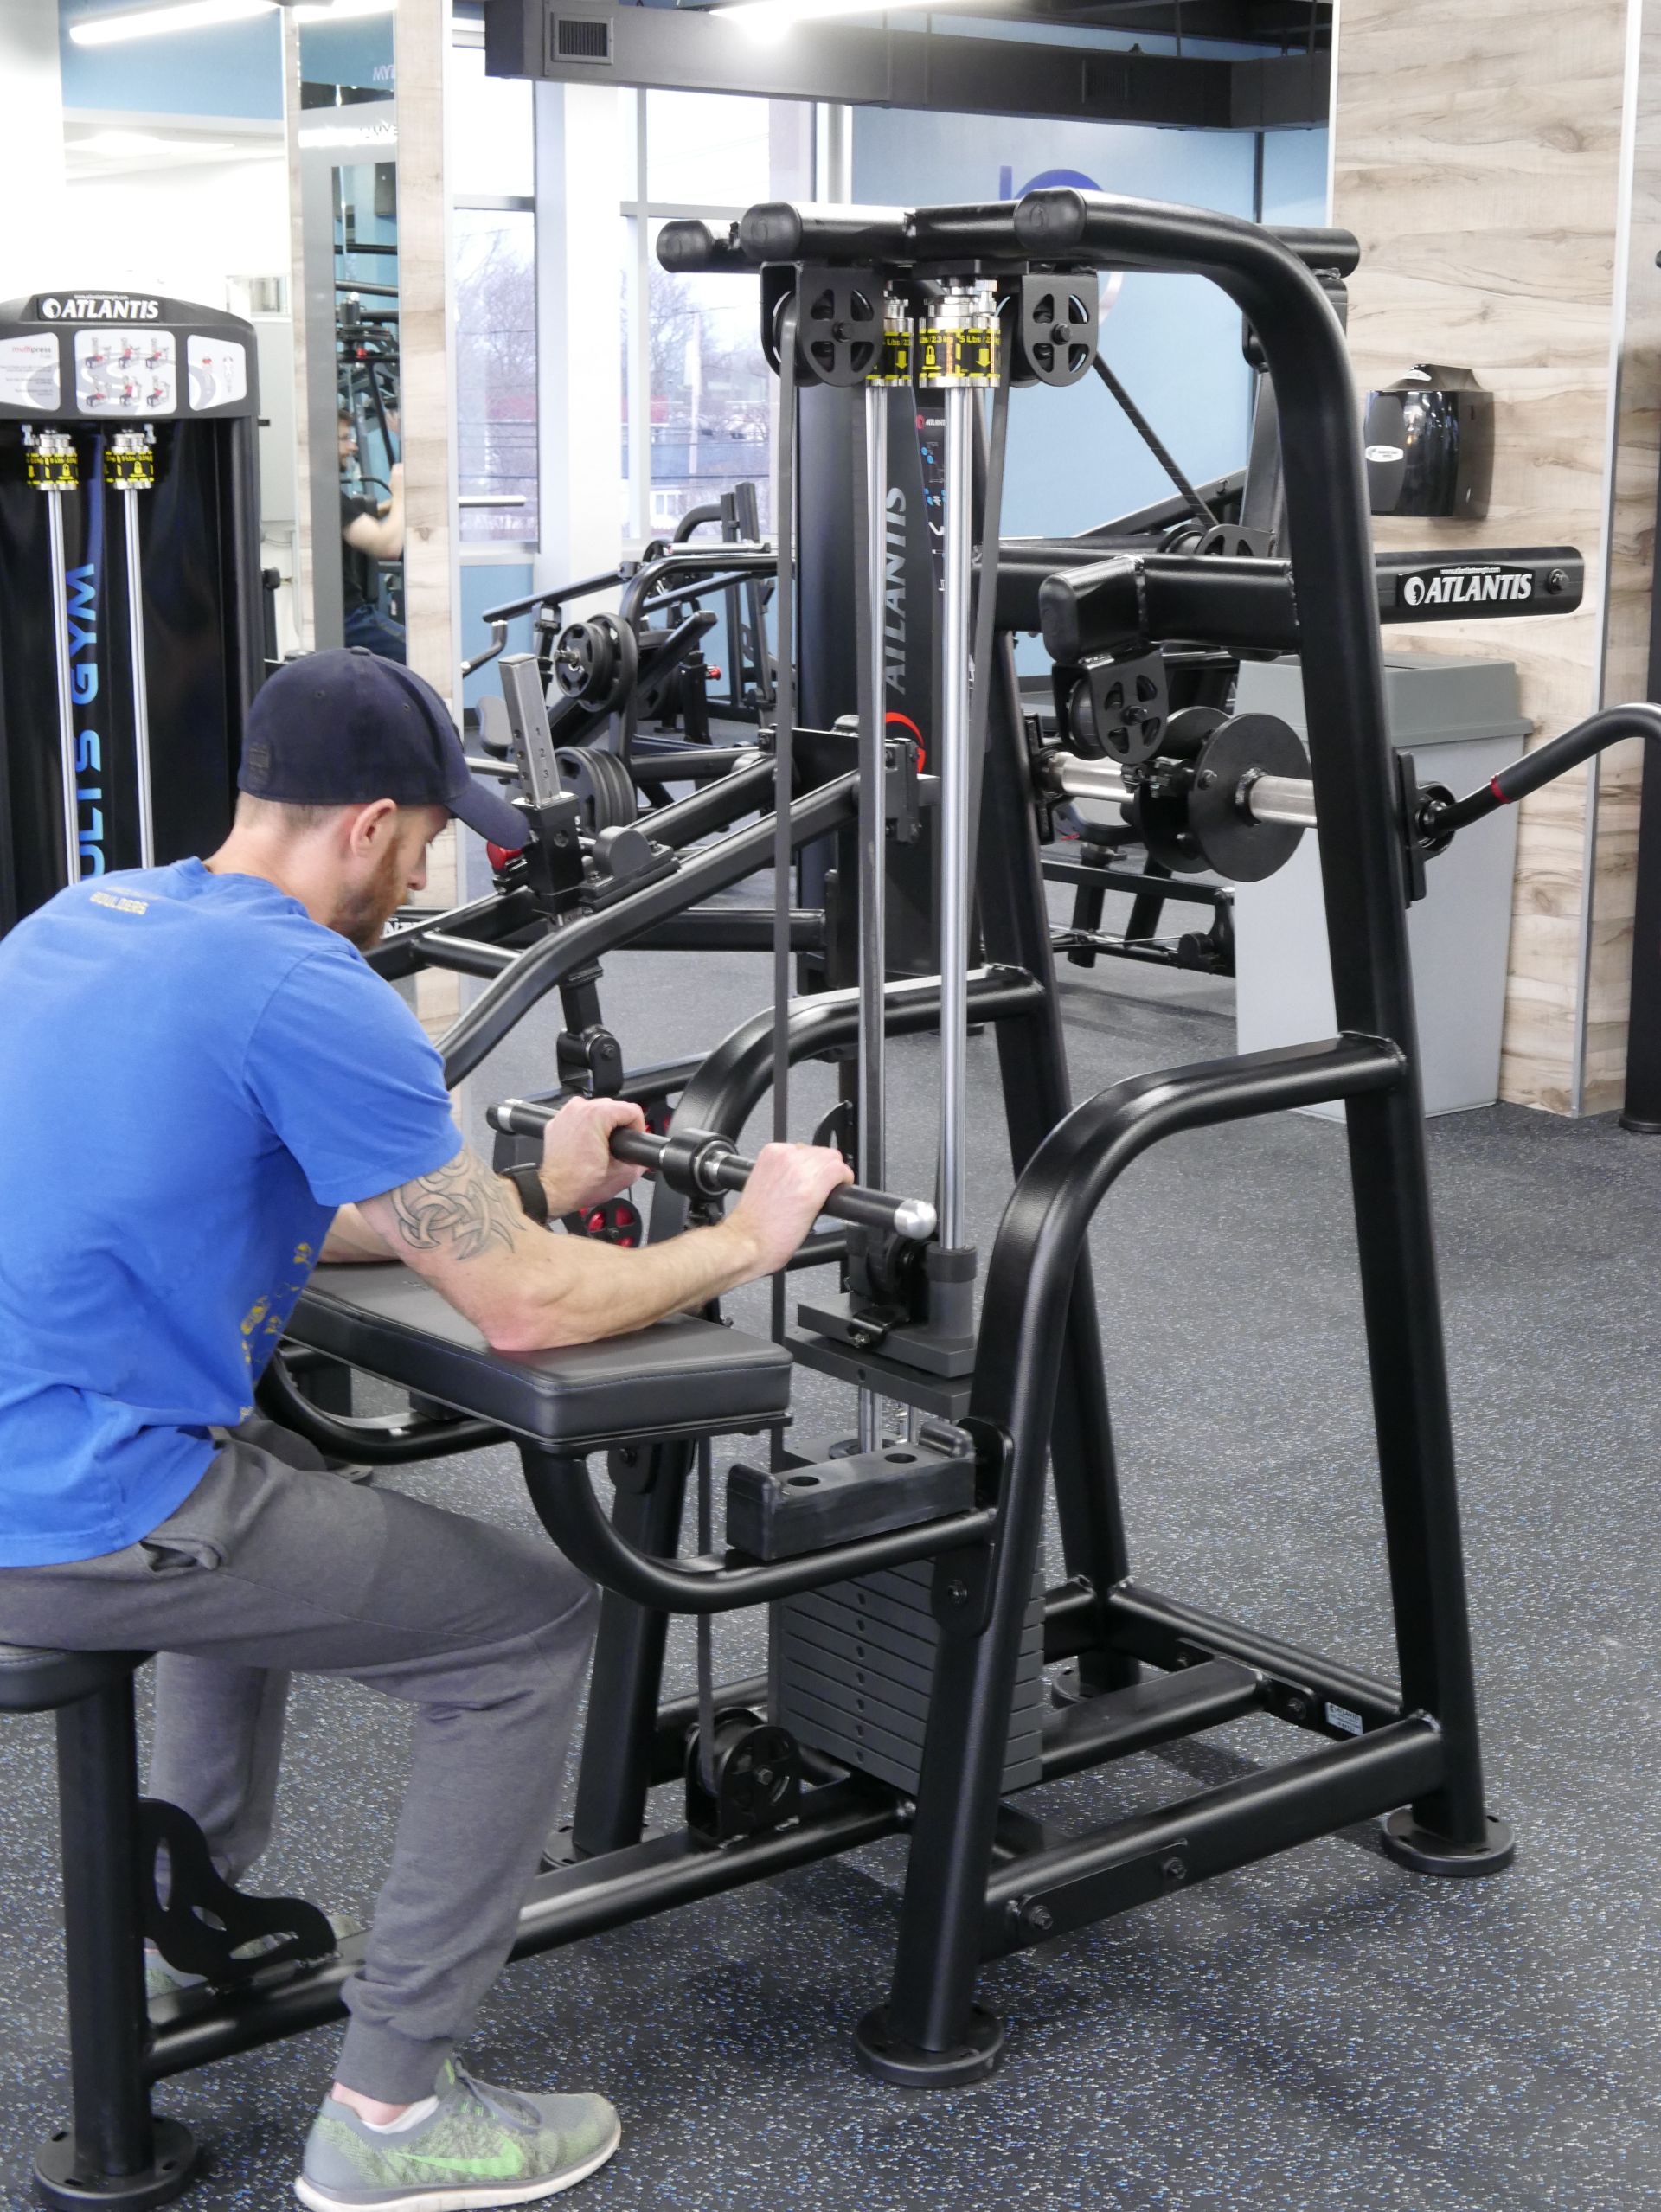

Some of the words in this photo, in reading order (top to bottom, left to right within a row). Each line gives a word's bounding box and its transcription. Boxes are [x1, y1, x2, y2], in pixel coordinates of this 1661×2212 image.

[61, 298, 159, 319] ATLANTIS
[1424, 574, 1533, 604] ATLANTIS
[65, 563, 99, 705] GYM
